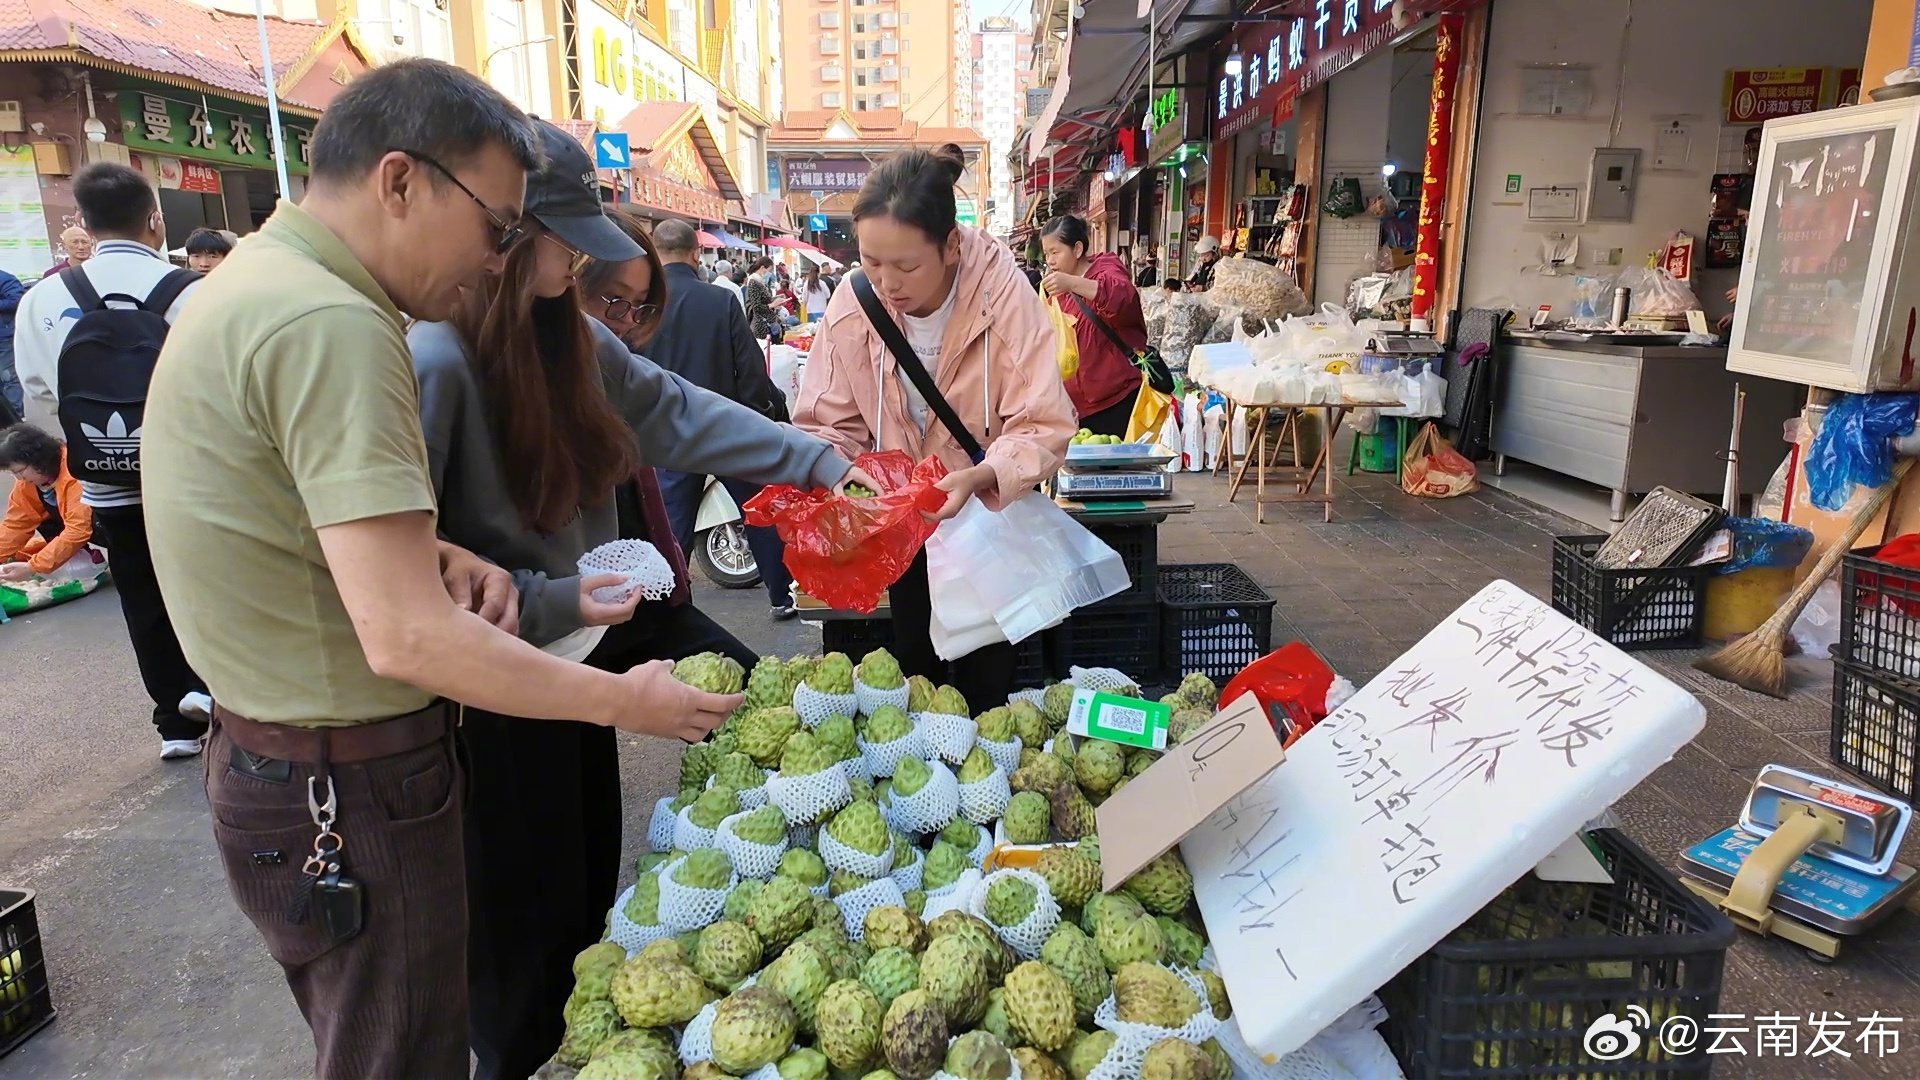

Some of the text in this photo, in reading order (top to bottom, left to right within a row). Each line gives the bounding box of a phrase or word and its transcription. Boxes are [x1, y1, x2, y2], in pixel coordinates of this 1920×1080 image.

[1218, 0, 1391, 119] 景洪市蚂蚁干货
